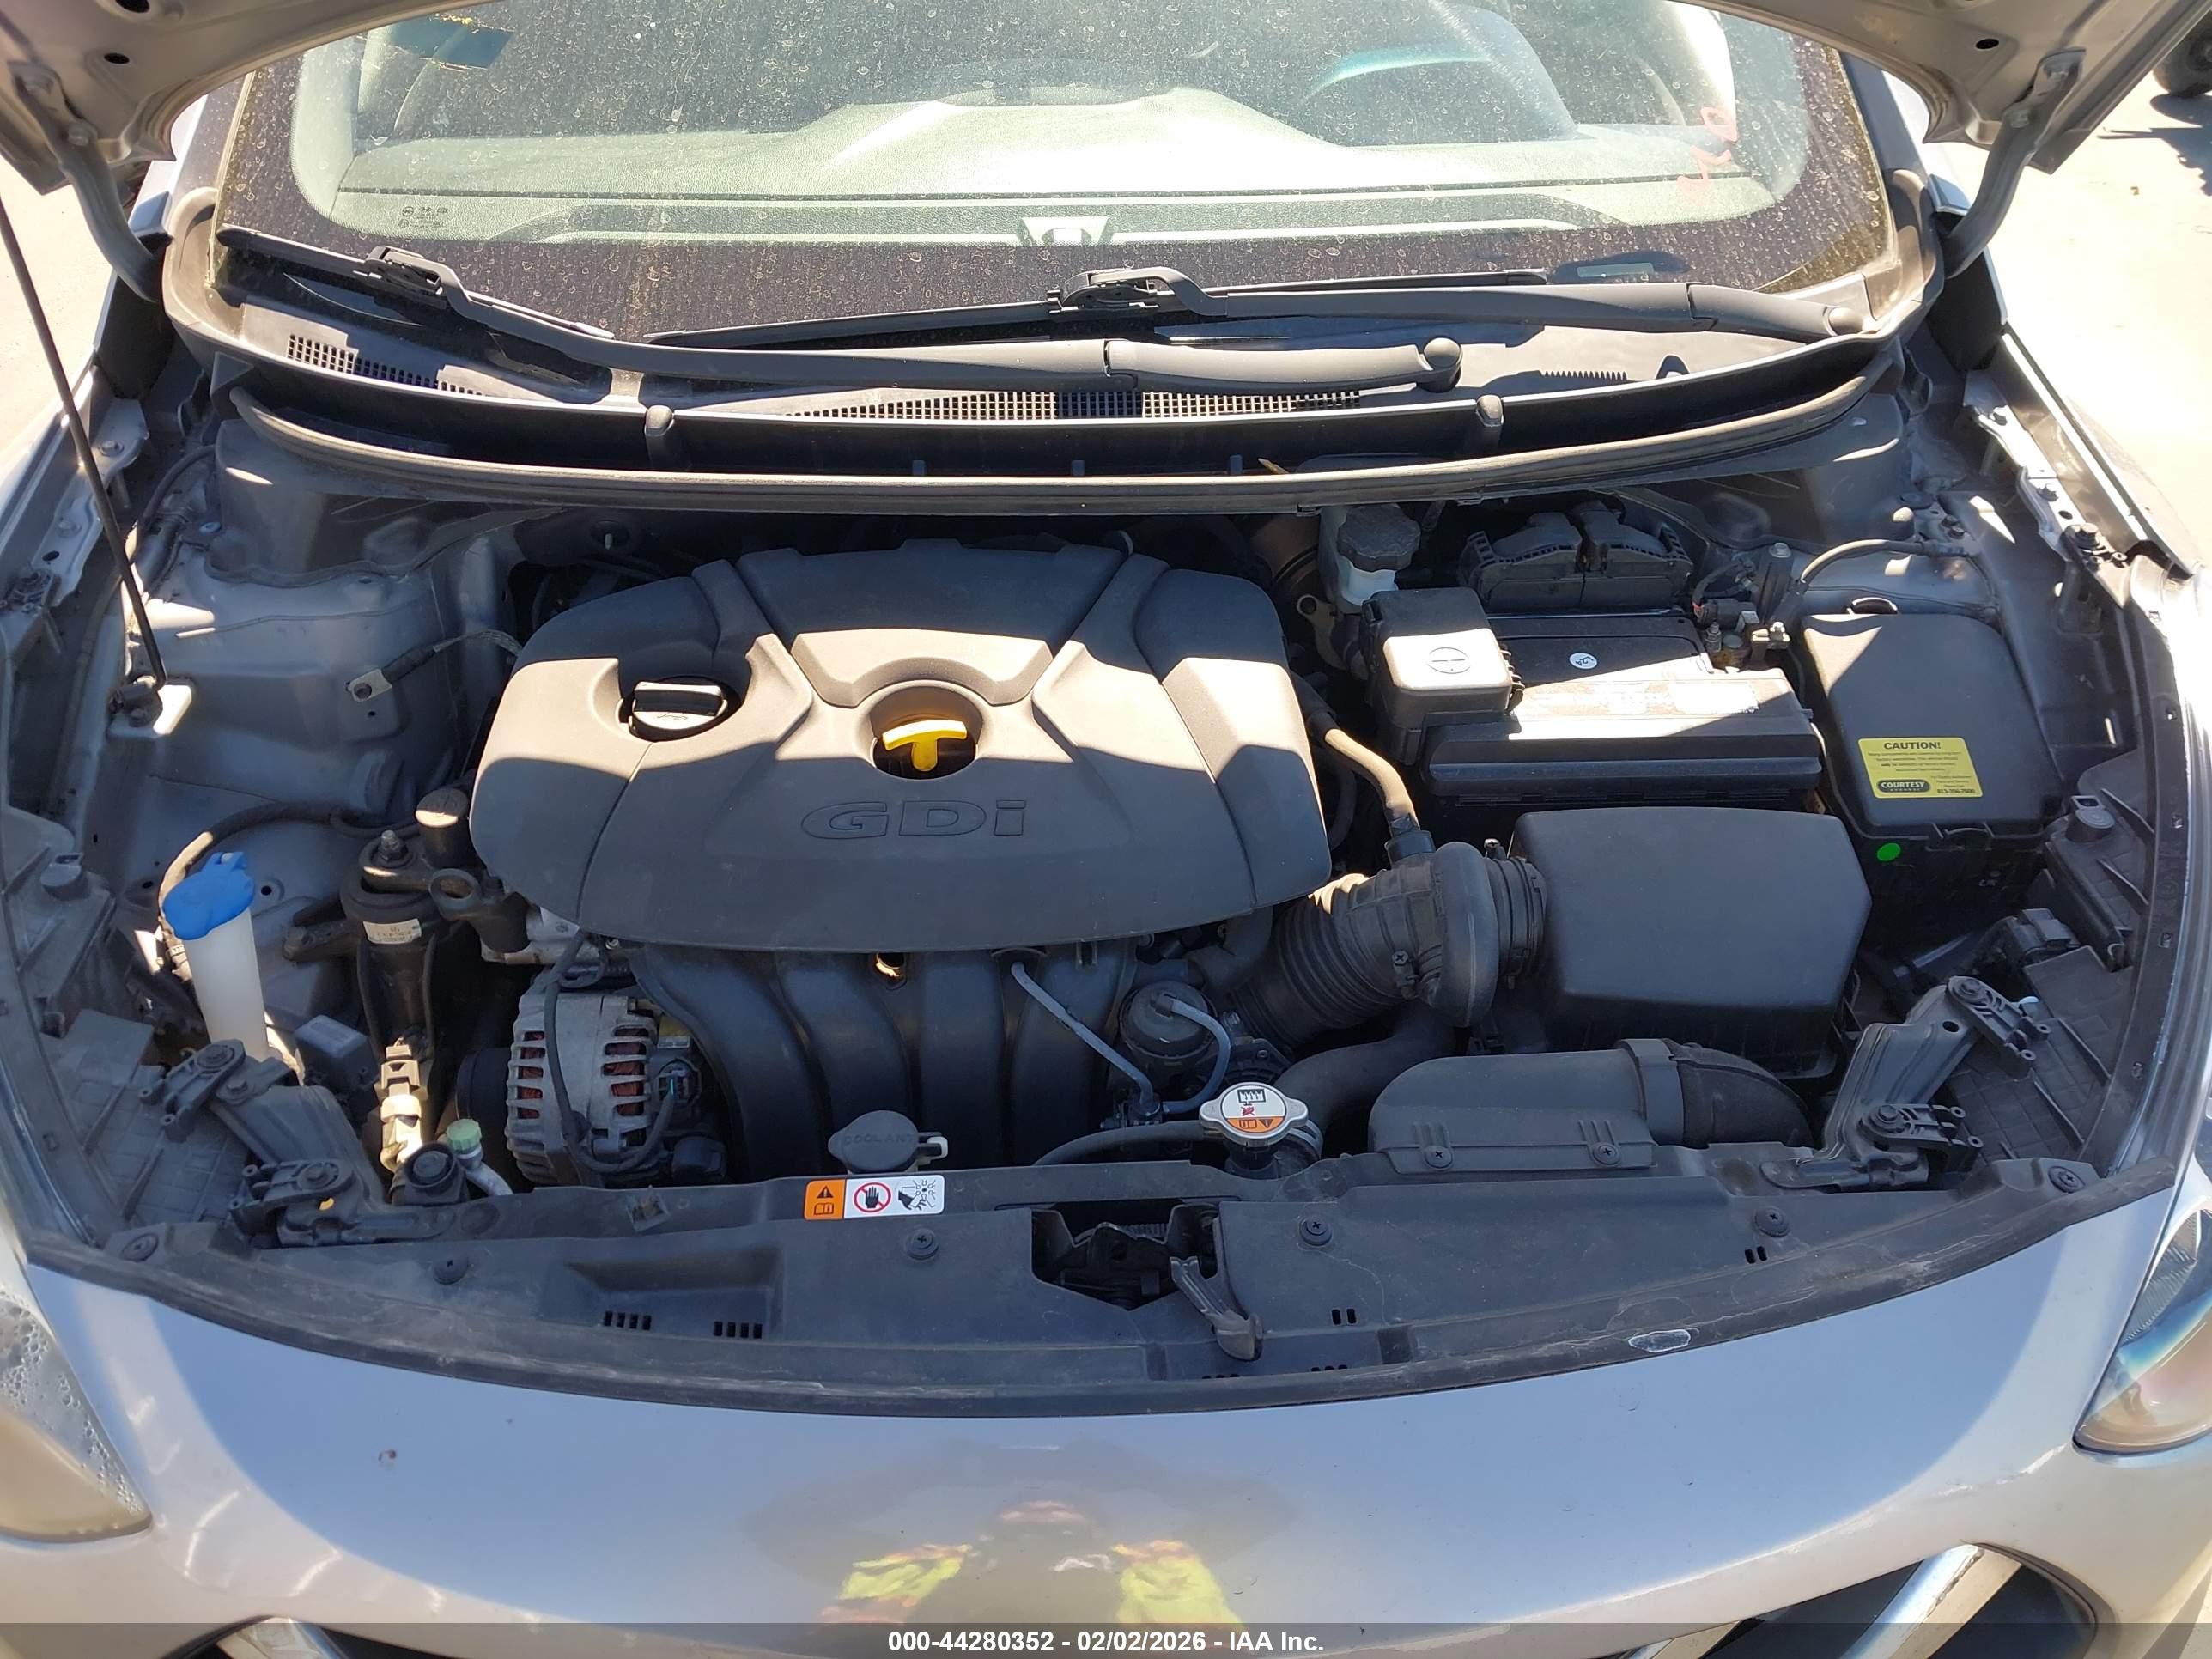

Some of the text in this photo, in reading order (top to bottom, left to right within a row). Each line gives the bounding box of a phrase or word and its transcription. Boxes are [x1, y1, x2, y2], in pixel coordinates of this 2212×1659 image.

[1883, 741, 1942, 750] CAUTION!
[800, 799, 1026, 840] GDi
[844, 1133, 913, 1145] COOLANT
